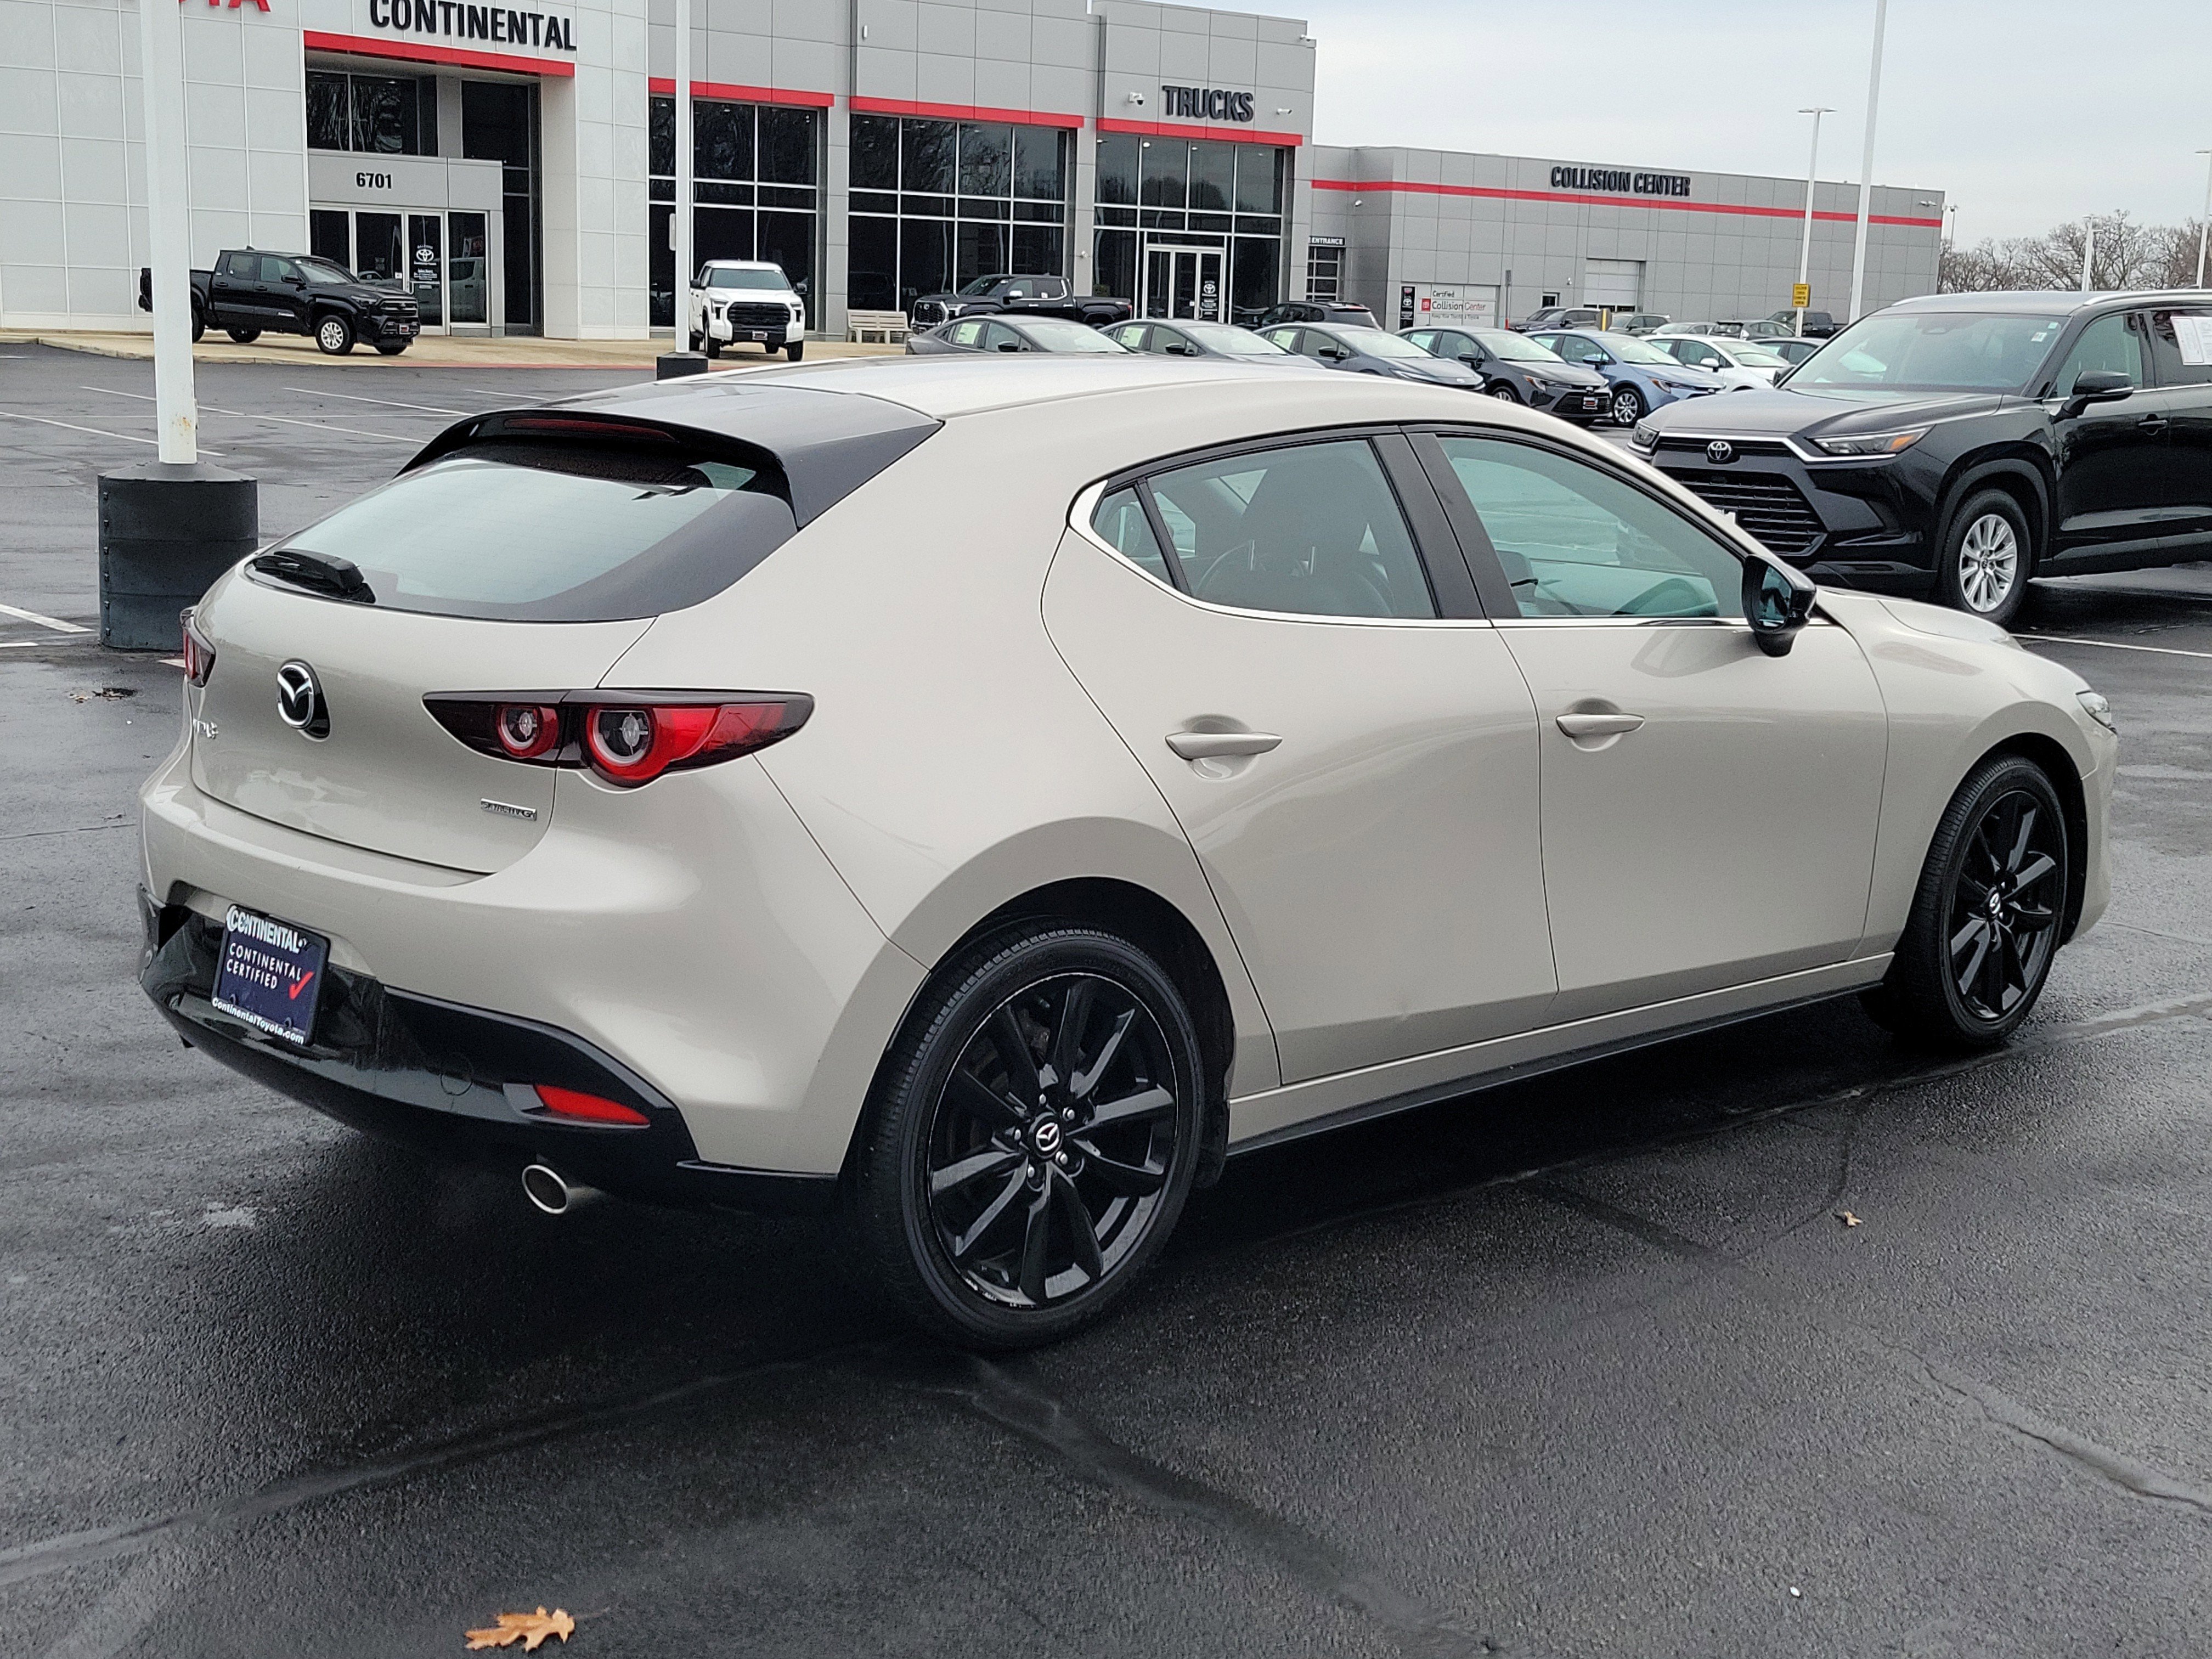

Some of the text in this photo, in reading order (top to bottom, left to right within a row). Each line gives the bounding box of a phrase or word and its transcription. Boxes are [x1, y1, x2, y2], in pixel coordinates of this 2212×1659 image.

[370, 0, 577, 51] CONTINENTAL
[1162, 86, 1254, 122] TRUCKS
[356, 172, 392, 189] 6701
[1551, 166, 1690, 196] COLLISION CENTER
[1432, 301, 1486, 311] Collision Center
[226, 906, 300, 953] CONTINENTAL
[227, 959, 278, 989] CERTIFIED
[229, 943, 302, 981] CONTINENTAL
[212, 997, 304, 1044] ContinentalToyota.com
